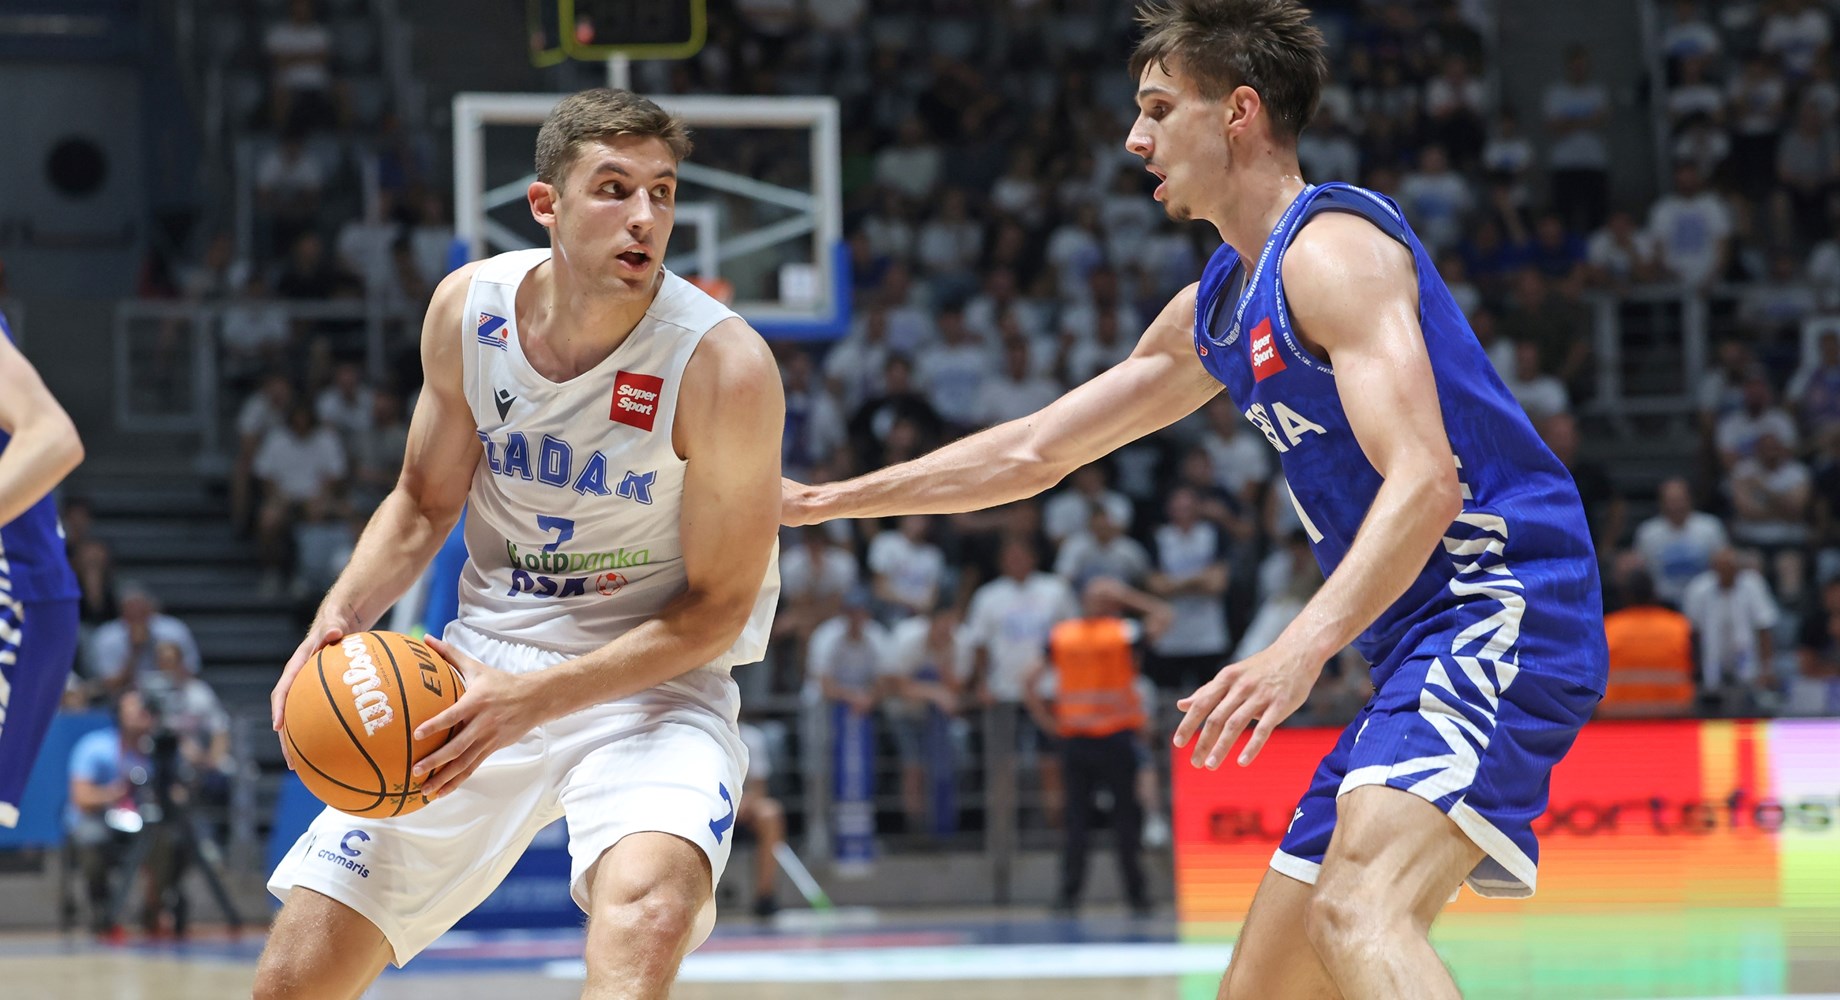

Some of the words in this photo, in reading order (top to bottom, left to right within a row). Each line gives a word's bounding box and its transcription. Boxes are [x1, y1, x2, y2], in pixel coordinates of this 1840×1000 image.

[617, 384, 657, 402] Super
[617, 397, 653, 415] Sport
[536, 514, 575, 552] 7
[317, 849, 370, 879] cromaris
